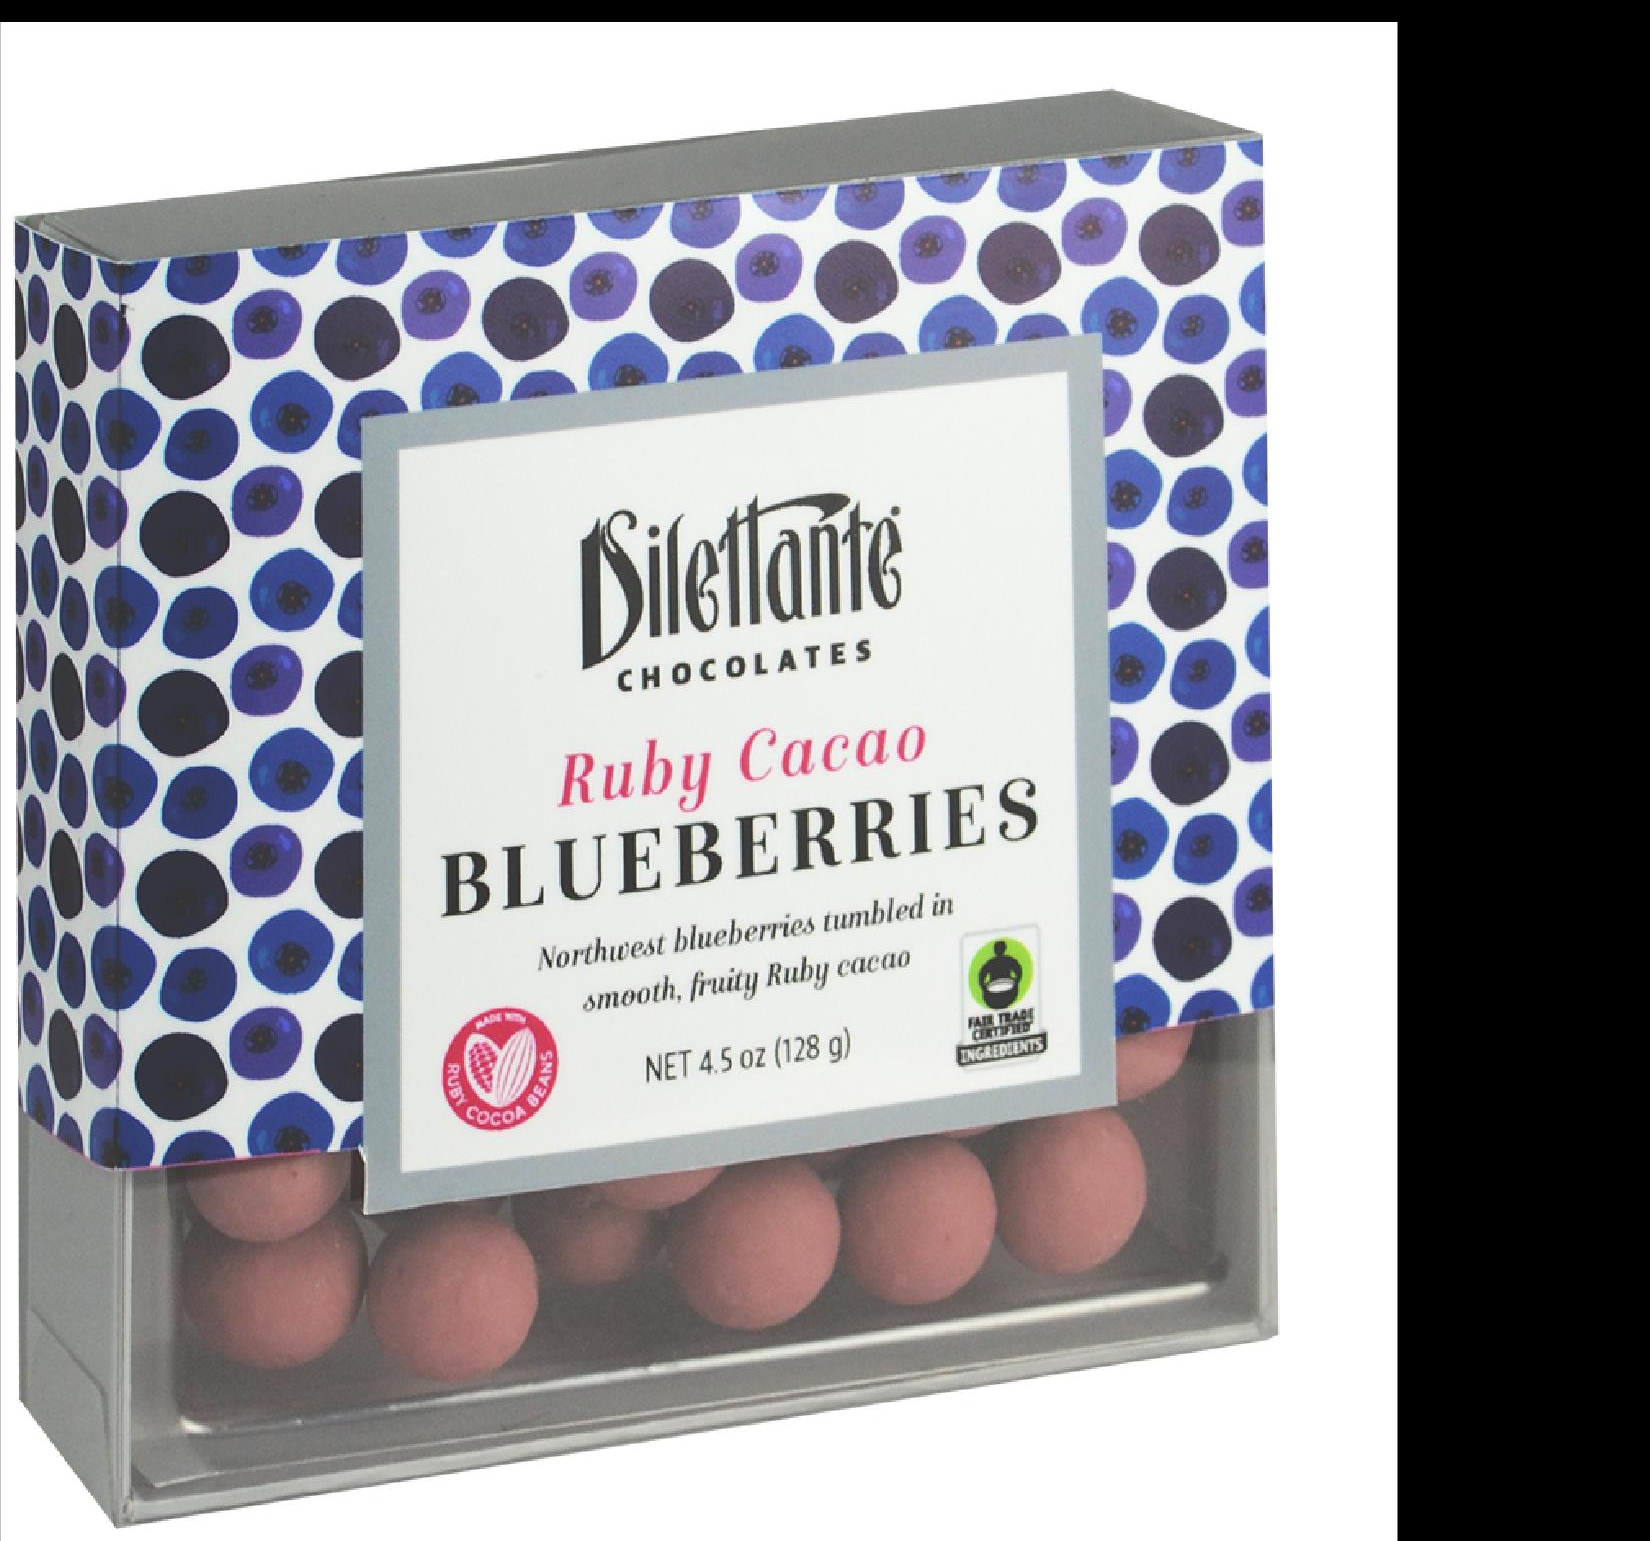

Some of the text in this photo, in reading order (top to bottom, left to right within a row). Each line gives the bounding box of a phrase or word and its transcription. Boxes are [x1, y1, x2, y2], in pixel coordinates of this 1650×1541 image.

[617, 639, 872, 692] CHOCOLATES
[557, 724, 927, 813] Ruby Cacao
[440, 777, 1039, 918] BLUEBERRIES
[537, 892, 955, 972] Northwest blueberries tumbled in
[582, 949, 912, 1013] smooth, fruity Ruby cacao
[645, 1027, 851, 1084] NET 4.5 oz (128 g)
